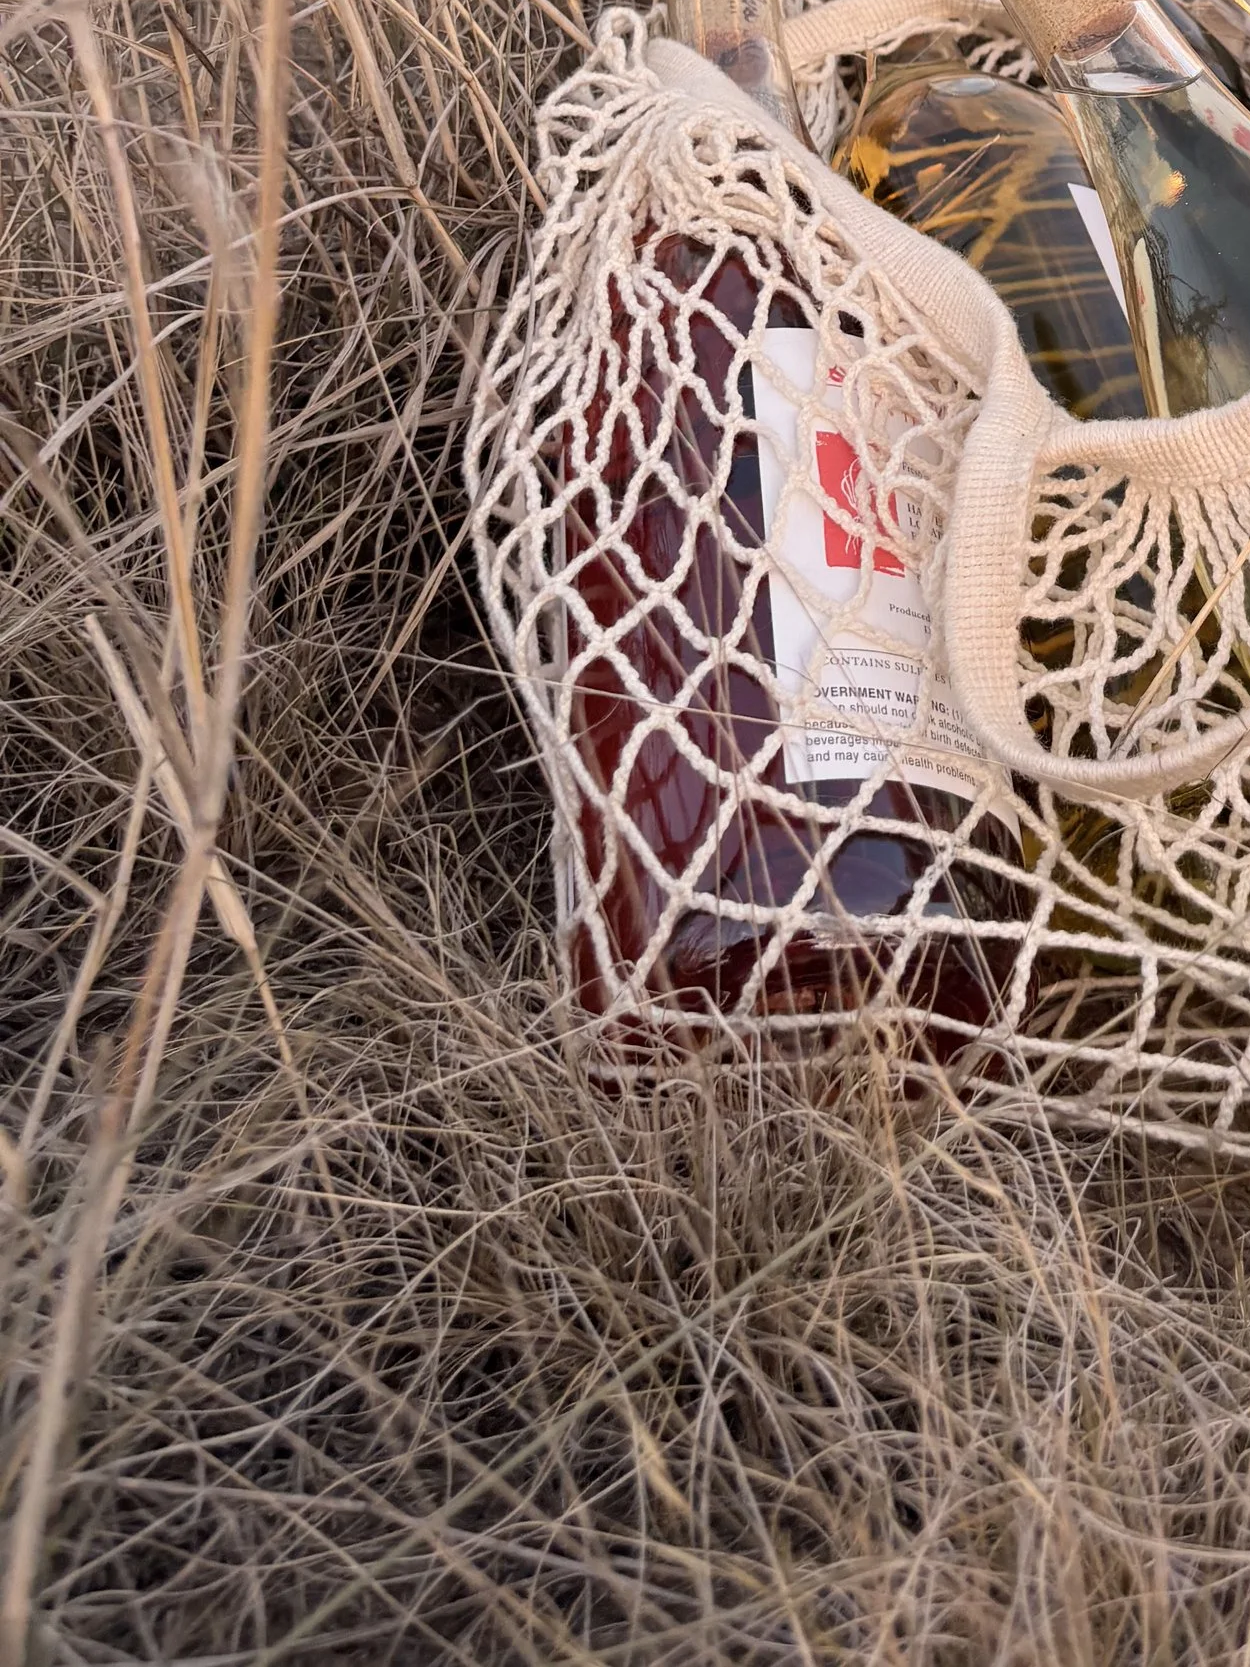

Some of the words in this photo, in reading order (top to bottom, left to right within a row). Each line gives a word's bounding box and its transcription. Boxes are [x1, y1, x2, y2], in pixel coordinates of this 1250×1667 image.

[889, 603, 932, 623] Produced
[814, 686, 892, 701] OVERNMENT
[894, 691, 950, 716] WARNG:
[850, 702, 888, 715] should
[891, 707, 908, 719] not
[805, 734, 869, 748] beverages
[930, 729, 952, 746] birth
[807, 750, 830, 763] and
[835, 751, 859, 764] may
